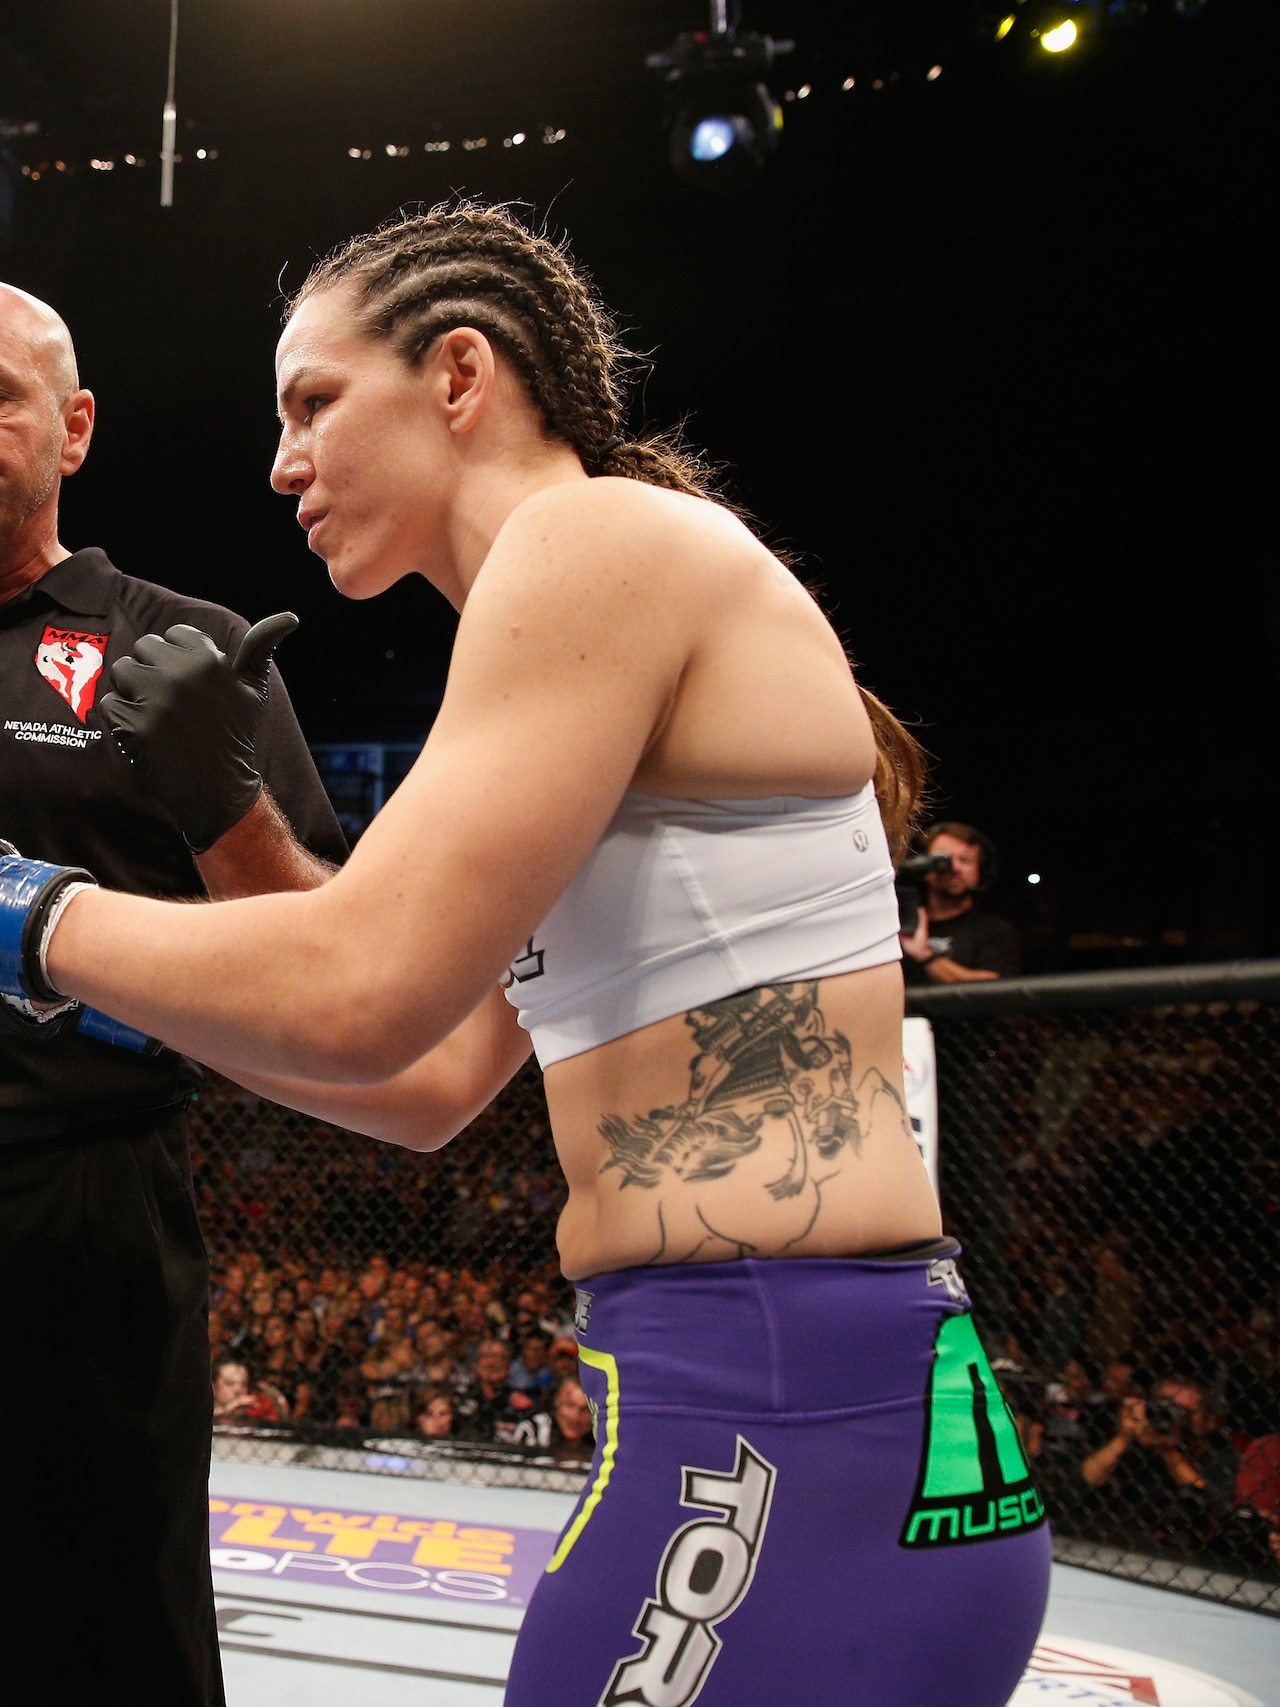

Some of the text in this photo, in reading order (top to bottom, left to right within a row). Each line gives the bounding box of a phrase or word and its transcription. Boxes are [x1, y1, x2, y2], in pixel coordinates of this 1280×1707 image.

[48, 630, 104, 644] MMA
[3, 720, 103, 740] NEVADA ATHLETIC
[14, 731, 87, 749] COMMISSION
[220, 1516, 515, 1576] LTE
[599, 1434, 777, 1707] TOR
